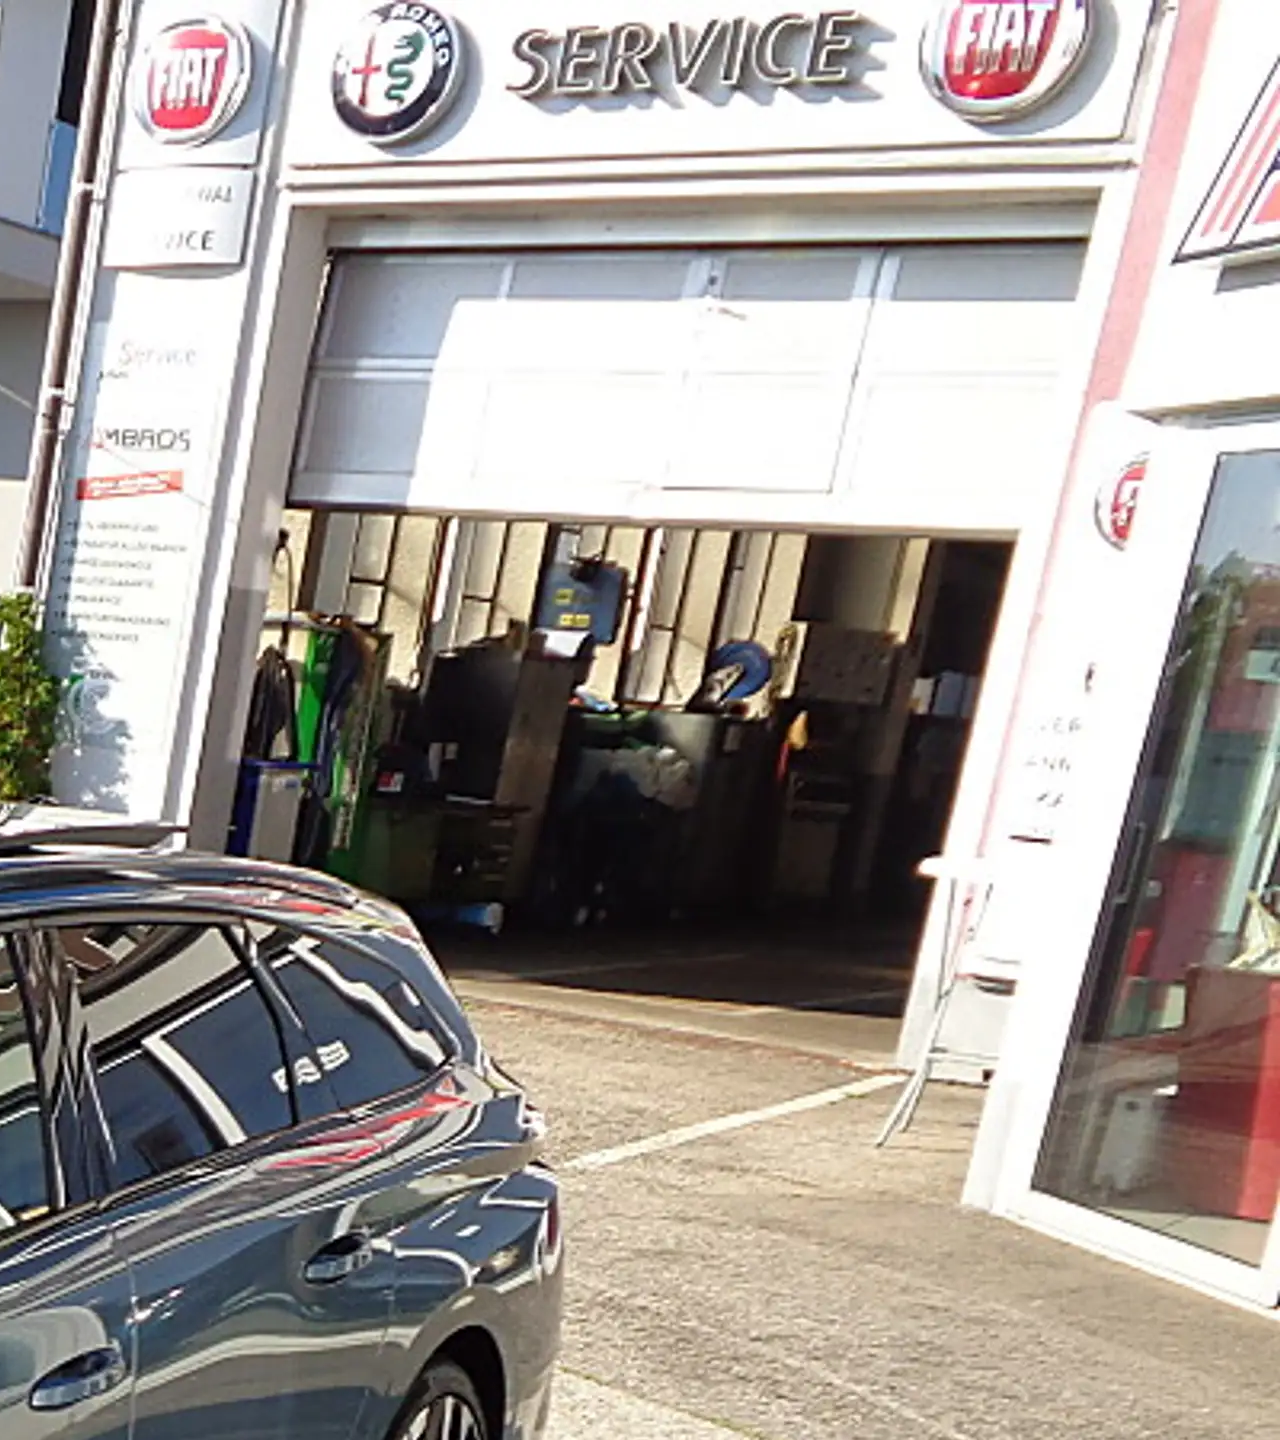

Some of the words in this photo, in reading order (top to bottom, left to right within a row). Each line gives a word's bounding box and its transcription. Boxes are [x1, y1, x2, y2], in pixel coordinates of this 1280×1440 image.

[390, 2, 451, 67] ROMEO
[506, 10, 860, 98] SERVICE
[953, 2, 1056, 75] FIAT
[152, 47, 225, 110] FIAT
